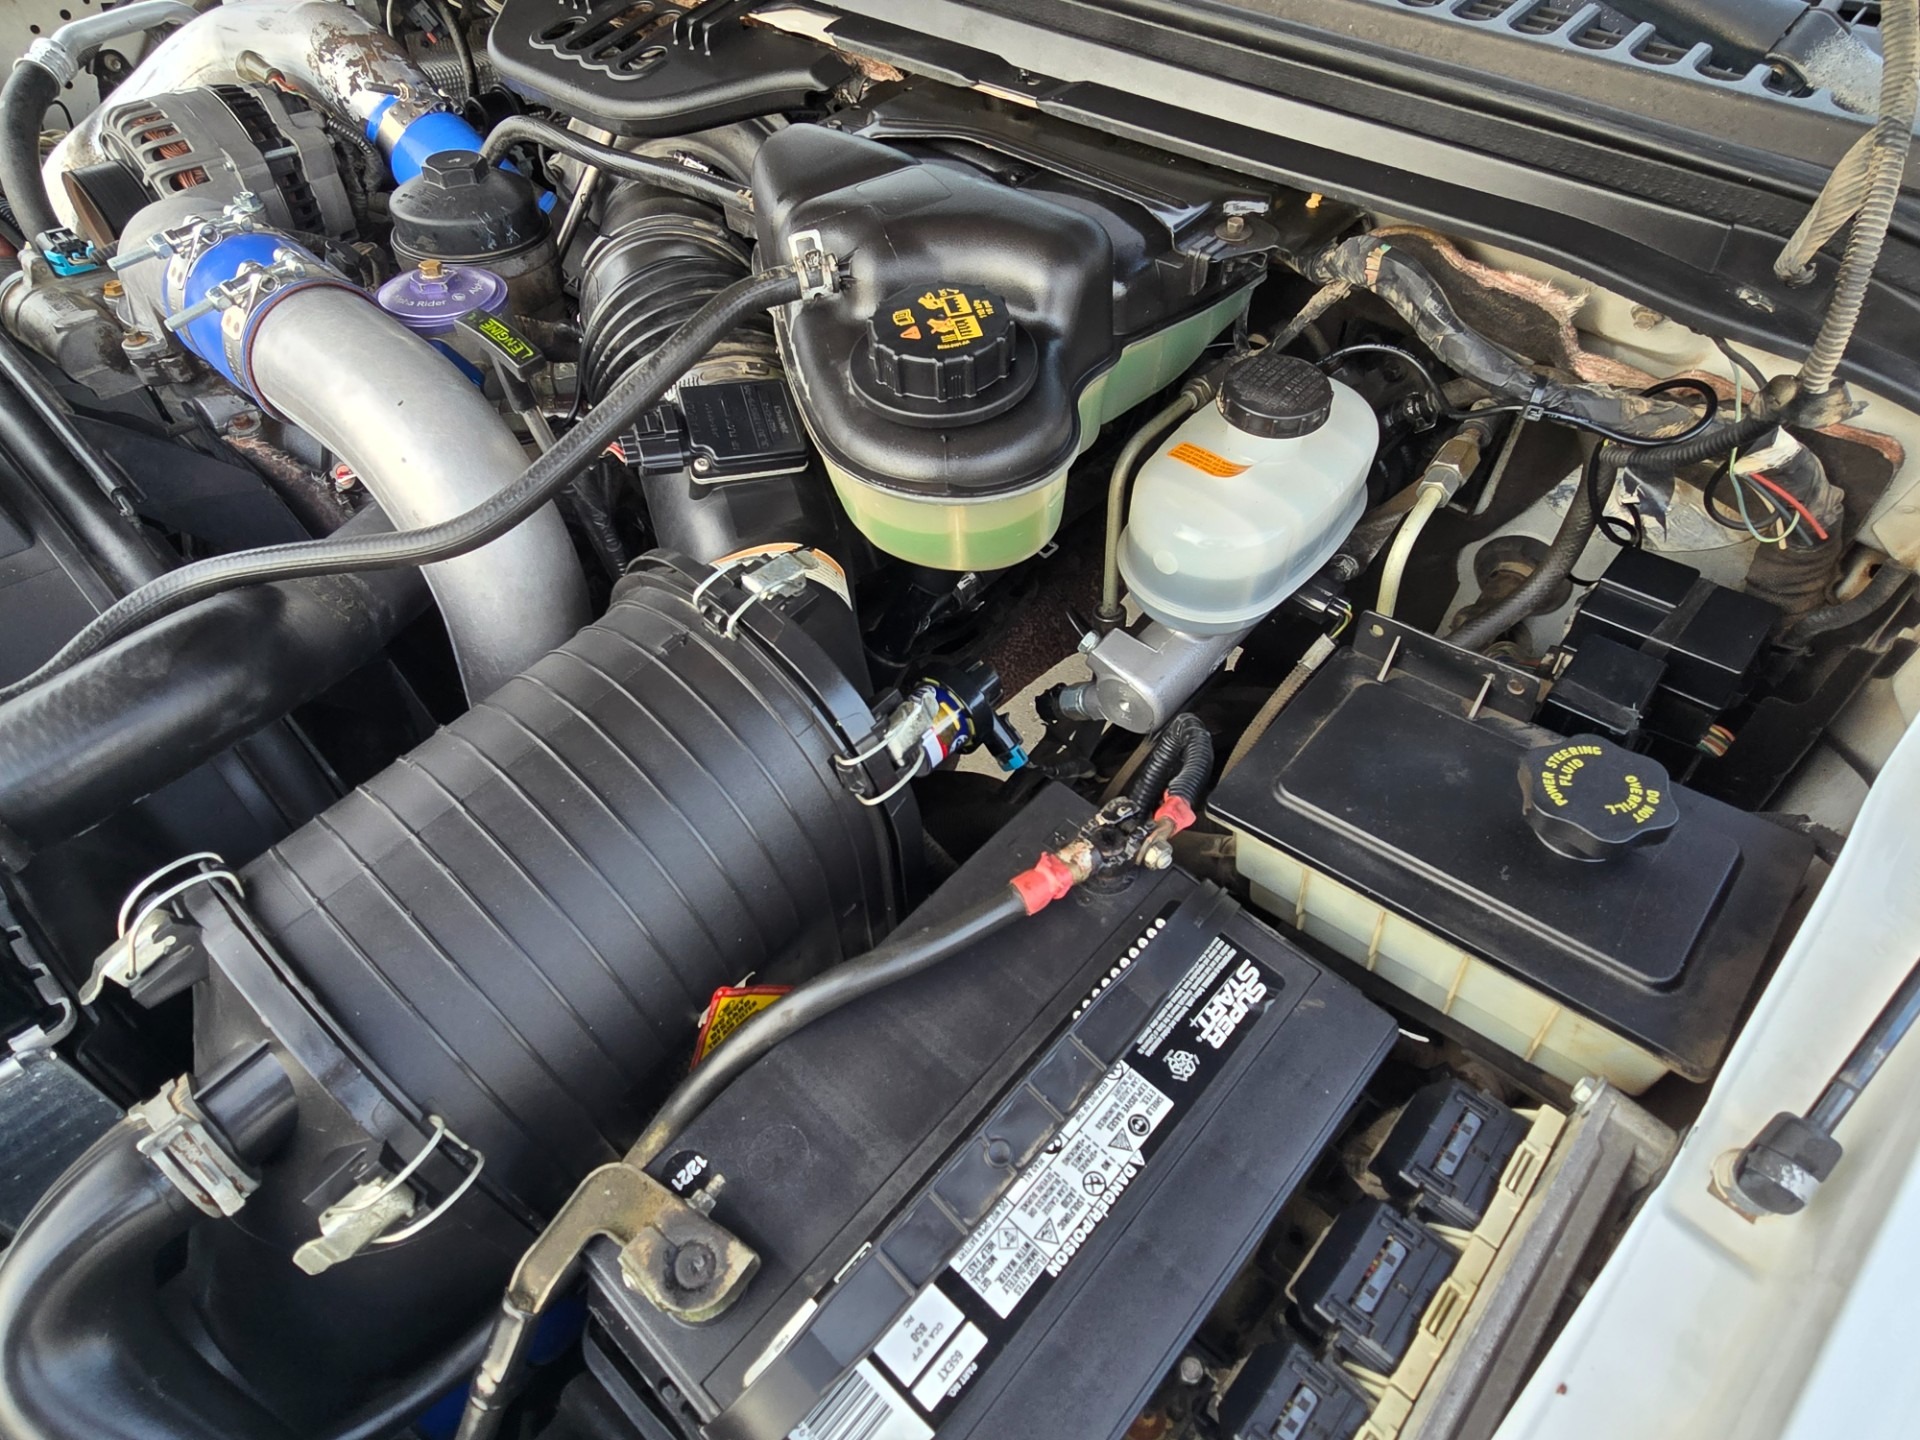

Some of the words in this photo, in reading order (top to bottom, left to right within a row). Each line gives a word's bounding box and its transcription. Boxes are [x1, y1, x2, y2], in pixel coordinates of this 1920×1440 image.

[417, 299, 446, 308] Rider
[482, 320, 524, 354] ENGINE
[1545, 746, 1602, 769] STEERING
[1559, 759, 1584, 786] FLUID
[1542, 772, 1568, 806] POWER
[1604, 775, 1643, 815] OVERFILL
[1646, 789, 1660, 804] DO
[1633, 805, 1656, 823] NOT
[1196, 958, 1261, 1040] START
[1205, 980, 1268, 1051] SUPER
[1125, 1071, 1135, 1081] OR
[1129, 1076, 1141, 1088] CAN
[1116, 1086, 1132, 1103] CAUSE
[1121, 1082, 1149, 1114] EXPLOSIVE
[1139, 1088, 1156, 1107] EYES.
[1094, 1101, 1120, 1131] BLINDNESS
[1145, 1095, 1165, 1117] SHIELD
[1106, 1111, 1125, 1132] GASES
[671, 1155, 710, 1191] 12/21
[1100, 1159, 1112, 1171] NO
[1035, 1171, 1054, 1193] SEVERE
[1055, 1184, 1069, 1198] CAN
[1034, 1177, 1061, 1209] BLINDNESS
[1059, 1190, 1077, 1209] ACID
[988, 1209, 1002, 1223] NOT
[1026, 1207, 1038, 1218] OR
[1041, 1195, 1060, 1216] CAUSE
[1055, 1197, 1085, 1231] SULFURIC
[976, 1220, 993, 1238] OPEN
[1044, 1163, 1138, 1278] DANGER/POISON
[978, 1240, 997, 1260] HELP
[1014, 1241, 1032, 1261] WITH
[962, 1257, 983, 1279] FAST.
[970, 1254, 998, 1286] MEDICAL
[994, 1258, 1019, 1286] WATER.
[1000, 1248, 1040, 1295] IMMEDIATELY
[1026, 1254, 1048, 1279] FLUSH
[977, 1277, 993, 1294] GET
[1012, 1276, 1030, 1296] EYES
[902, 1314, 916, 1329] RC
[928, 1321, 945, 1340] CCA
[908, 1322, 929, 1343] 850
[935, 1349, 965, 1383] 65EXT
[957, 1361, 979, 1385] PART
[946, 1381, 963, 1399] NO.
